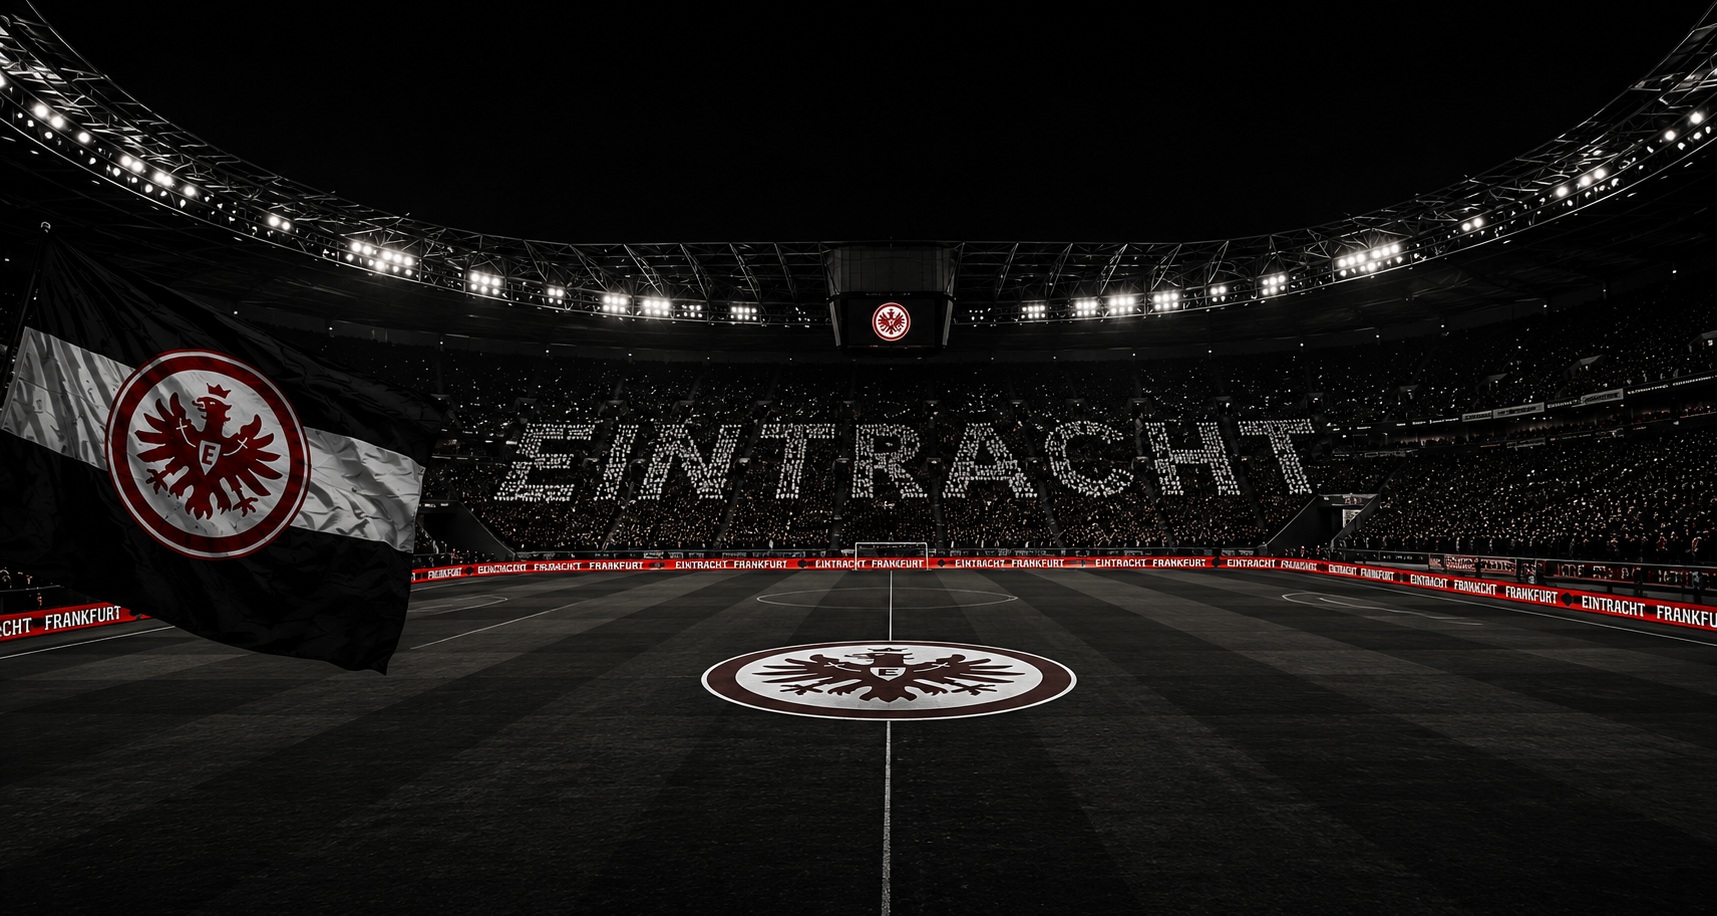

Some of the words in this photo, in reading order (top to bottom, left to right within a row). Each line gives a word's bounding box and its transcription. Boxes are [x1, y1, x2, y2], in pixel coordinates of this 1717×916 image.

[202, 444, 216, 466] E
[494, 420, 1315, 501] EINTRACHT
[675, 560, 728, 569] EINTRACHT
[733, 560, 788, 569] FRANKFURT
[955, 559, 1005, 568] EINTRACHT
[1011, 559, 1065, 568] FRANKFURT
[1095, 558, 1147, 567] EINTRACHT
[1152, 558, 1206, 567] FRANKFURT
[1505, 585, 1559, 604] FRANKFURT
[44, 605, 121, 630] FRANKFURT
[1581, 595, 1646, 617] EINTRACHT
[1656, 605, 1717, 628] FRANKFU
